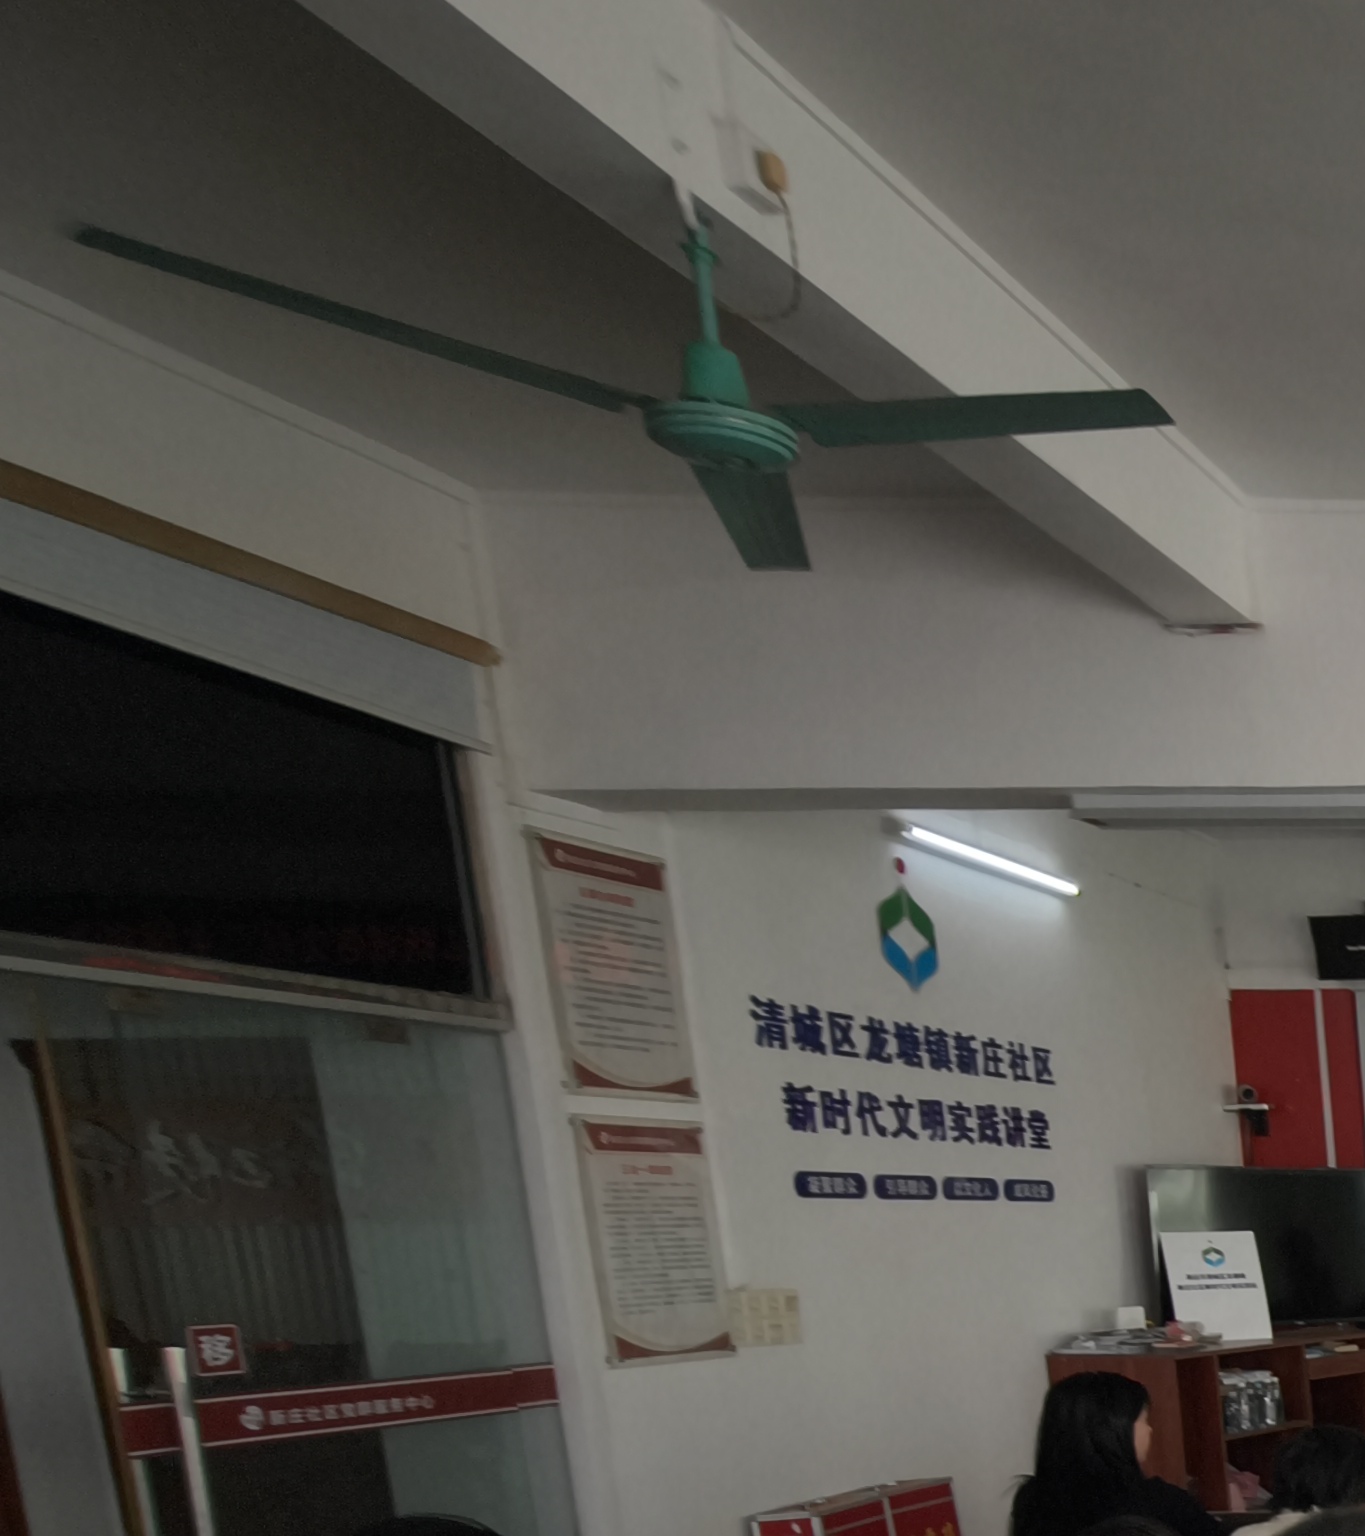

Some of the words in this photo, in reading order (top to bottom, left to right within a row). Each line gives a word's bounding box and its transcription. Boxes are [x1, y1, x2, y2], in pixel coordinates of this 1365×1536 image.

[749, 994, 1056, 1086] 清城区龙塘镇新庄社区
[781, 1081, 1052, 1150] 新时代文明实践讲堂
